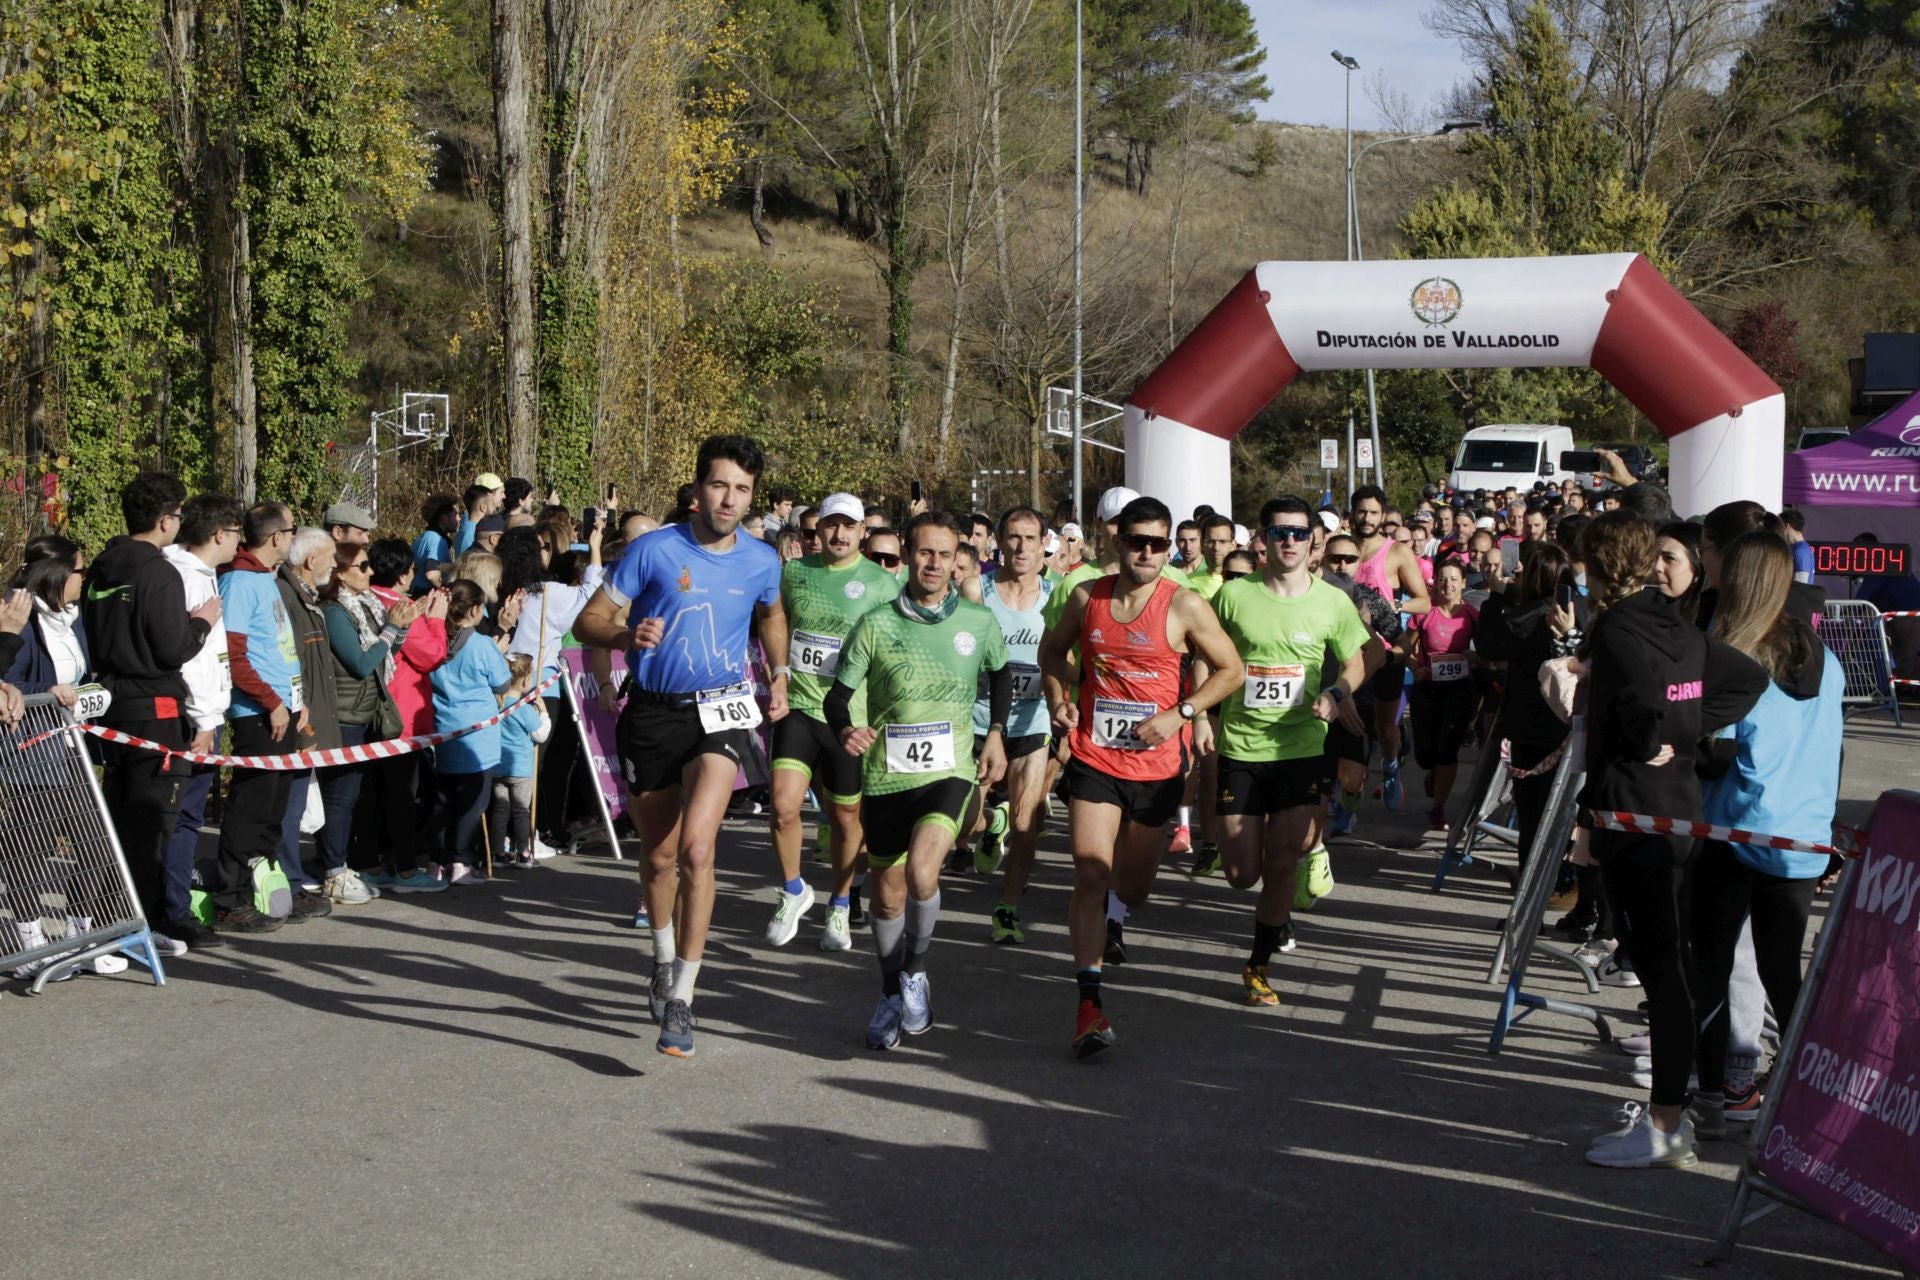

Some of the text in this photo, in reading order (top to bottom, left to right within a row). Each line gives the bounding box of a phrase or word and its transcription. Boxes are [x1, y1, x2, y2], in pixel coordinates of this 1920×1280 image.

[1423, 335, 1446, 348] DE
[1451, 330, 1560, 348] VALLADOLID
[802, 647, 823, 667] 66
[1438, 663, 1462, 676] 299
[1255, 681, 1290, 700] 251
[80, 694, 104, 714] 968
[714, 701, 751, 722] 160
[919, 724, 948, 732] POPULAR
[906, 741, 934, 762] 42
[1809, 1158, 1836, 1185] web
[1830, 1167, 1851, 1192] de
